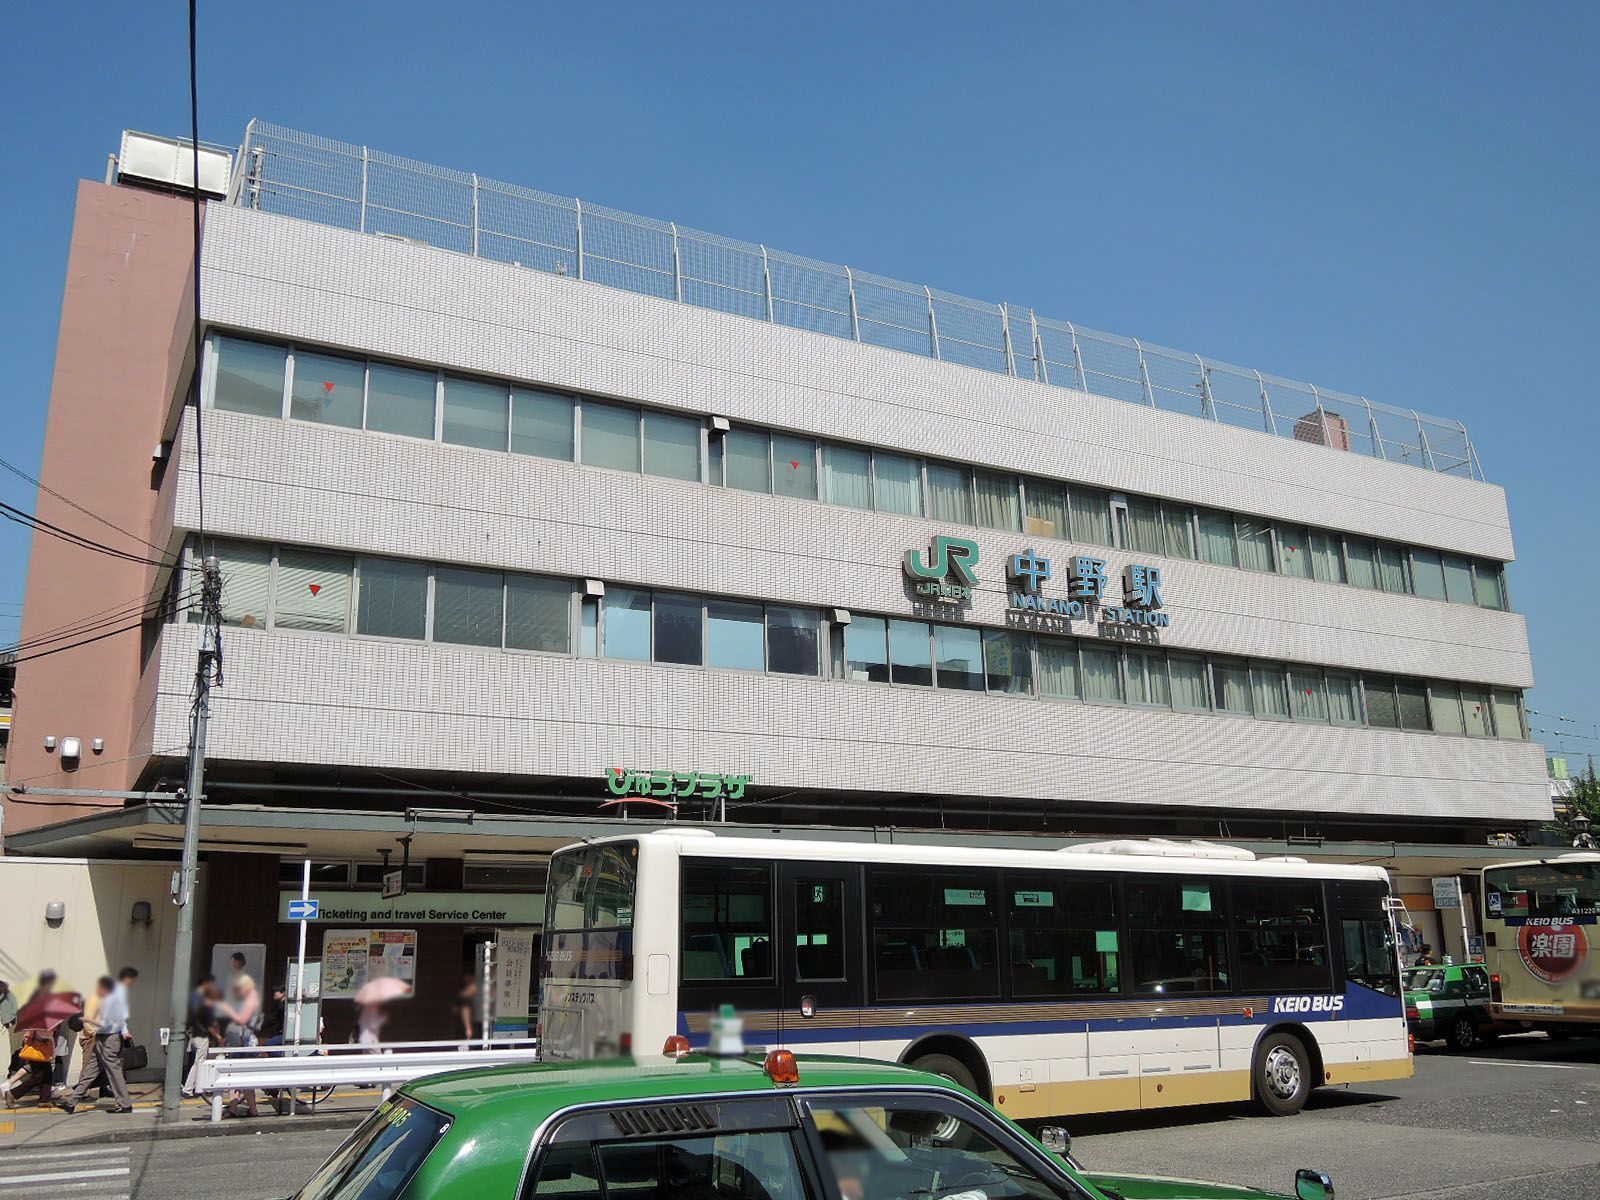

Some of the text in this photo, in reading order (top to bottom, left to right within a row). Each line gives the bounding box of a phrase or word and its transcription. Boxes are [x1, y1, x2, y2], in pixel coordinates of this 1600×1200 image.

[904, 535, 979, 587] JR
[917, 582, 972, 600] JR東日本
[1010, 547, 1165, 610] 中野駅
[1013, 592, 1170, 628] NAKANO STATION
[606, 768, 753, 799] びゅうプラザ
[319, 908, 507, 921] Ticketing and travel Service Center
[1526, 917, 1574, 926] KEIO BUS
[1532, 932, 1575, 958] 楽園
[1273, 995, 1344, 1013] KEIO BUS
